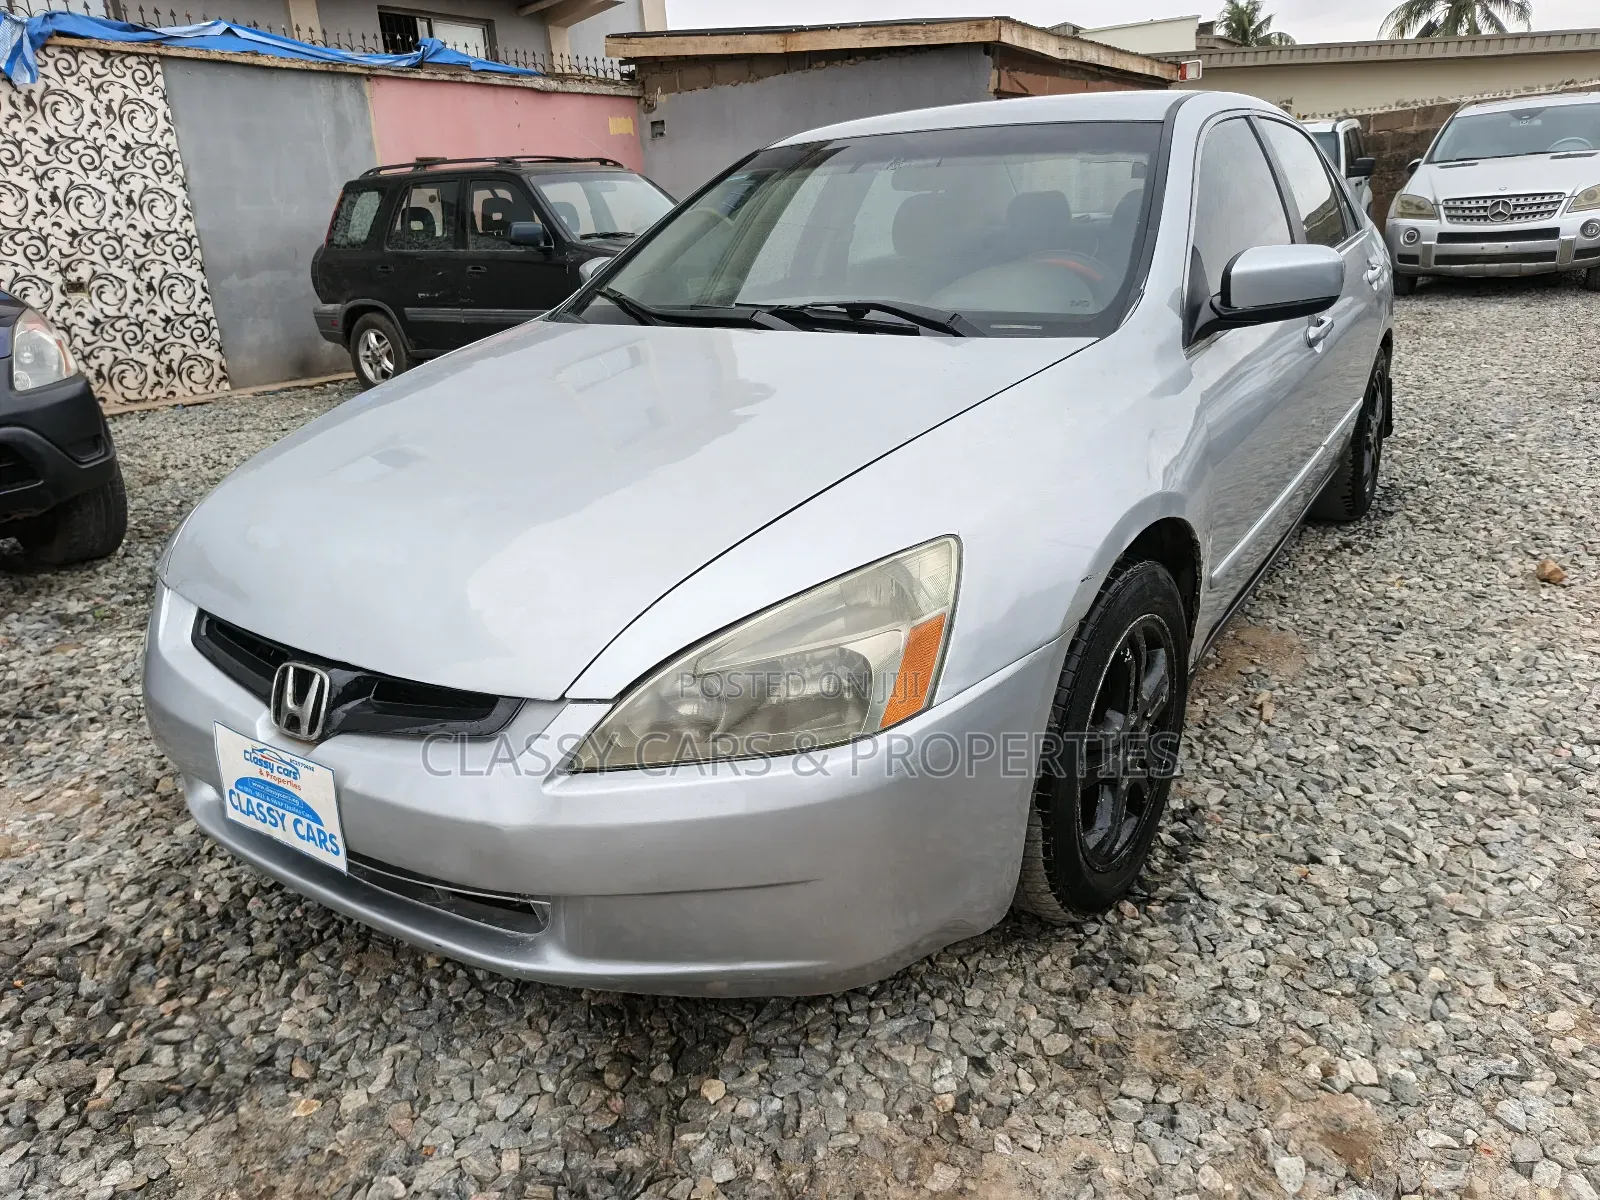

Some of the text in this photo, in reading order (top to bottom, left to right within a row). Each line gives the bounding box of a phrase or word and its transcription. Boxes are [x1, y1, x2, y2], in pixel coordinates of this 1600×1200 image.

[244, 749, 274, 773] Classy
[265, 770, 301, 791] Properties
[229, 788, 340, 857] CLASSY CARS
